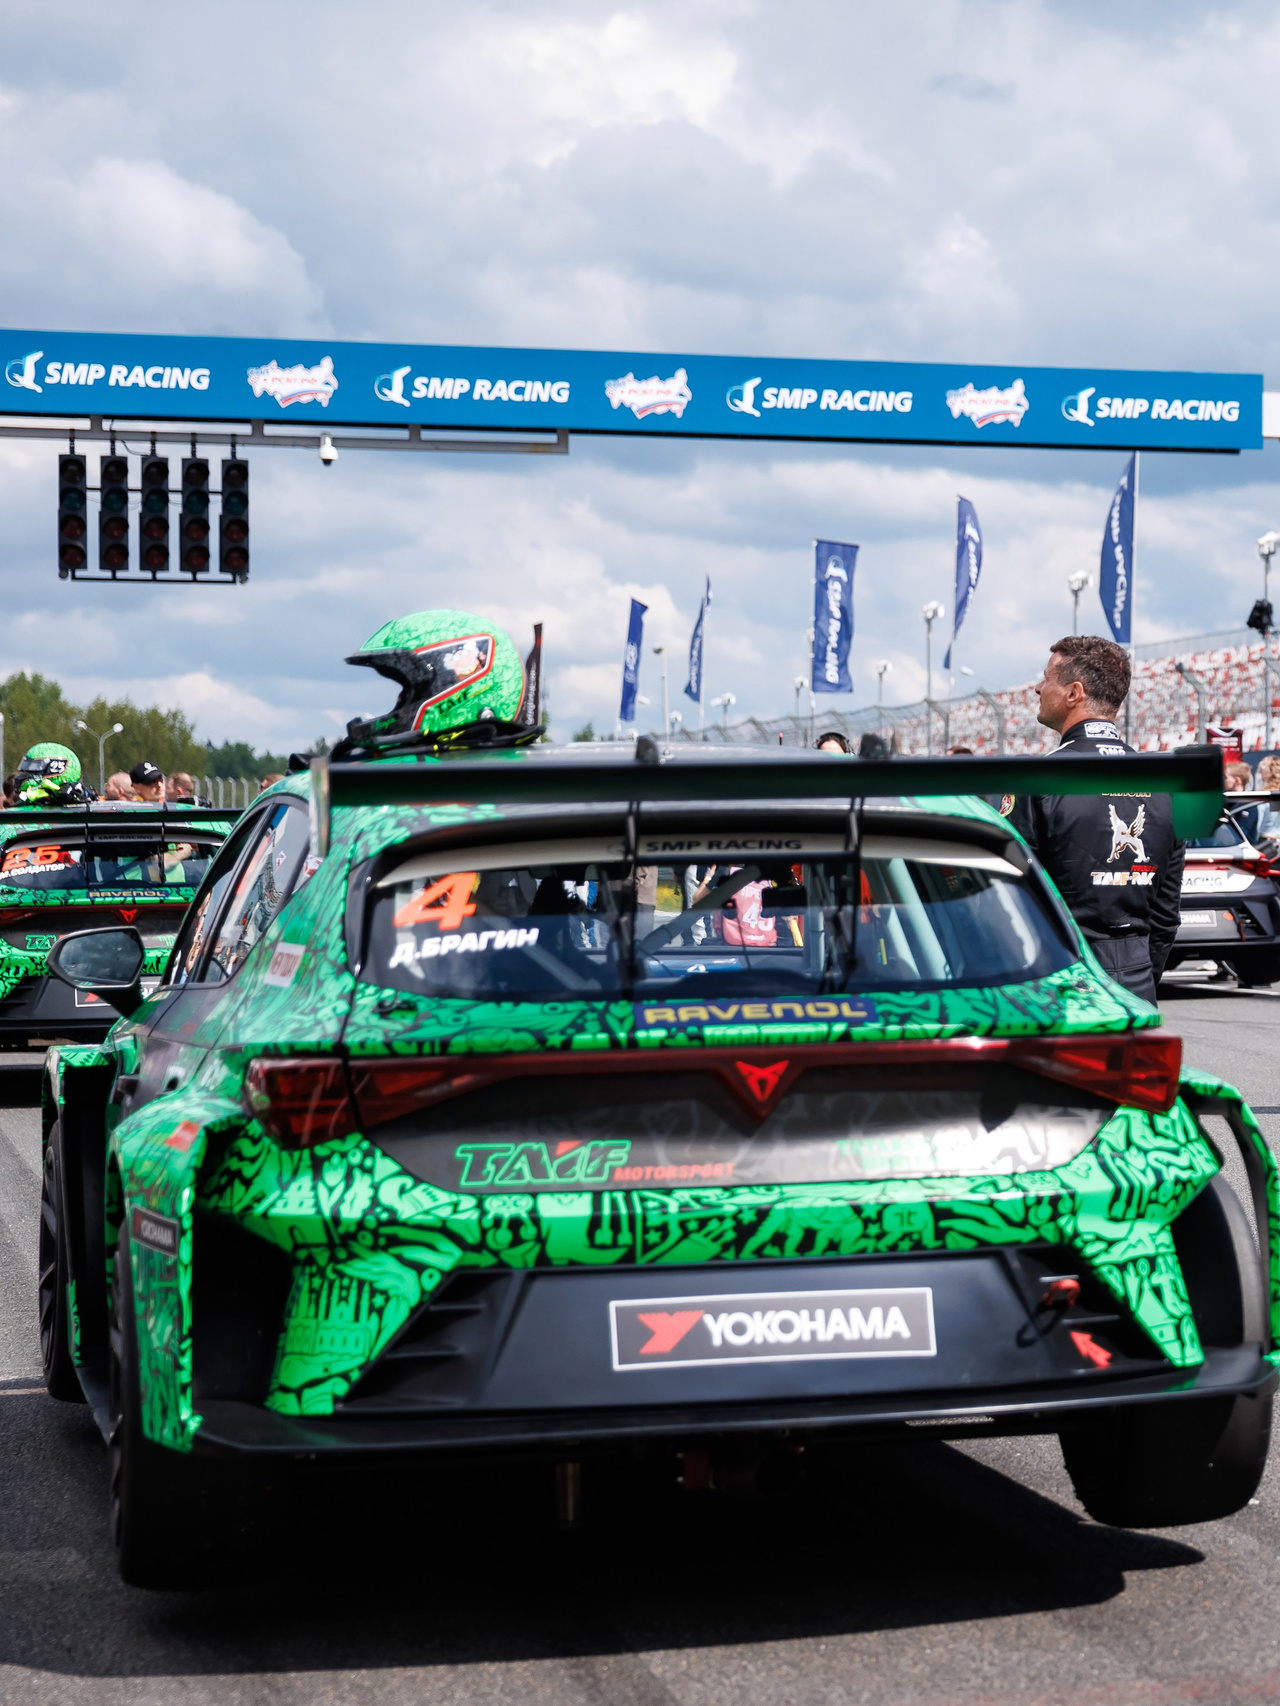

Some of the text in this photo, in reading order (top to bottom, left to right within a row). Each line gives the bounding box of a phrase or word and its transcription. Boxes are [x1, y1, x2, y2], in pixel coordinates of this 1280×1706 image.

[44, 362, 210, 390] SMP RACING
[411, 376, 570, 403] SMP RACING
[761, 387, 913, 413] SMP RACING
[1095, 397, 1240, 422] SMP RACING
[49, 761, 66, 773] 25
[1, 844, 62, 872] 25
[646, 839, 803, 852] SMP RACING
[89, 890, 166, 898] RAVENOL
[1180, 876, 1223, 887] ACING
[393, 871, 477, 931] 4
[1181, 913, 1212, 923] OHAMA
[388, 927, 540, 969] Д.БРАГИН
[643, 1001, 868, 1026] RAVENOL
[455, 1139, 632, 1187] TAIF
[612, 1162, 737, 1183] MOTORSPORT
[703, 1307, 911, 1346] YOKOHAMA
